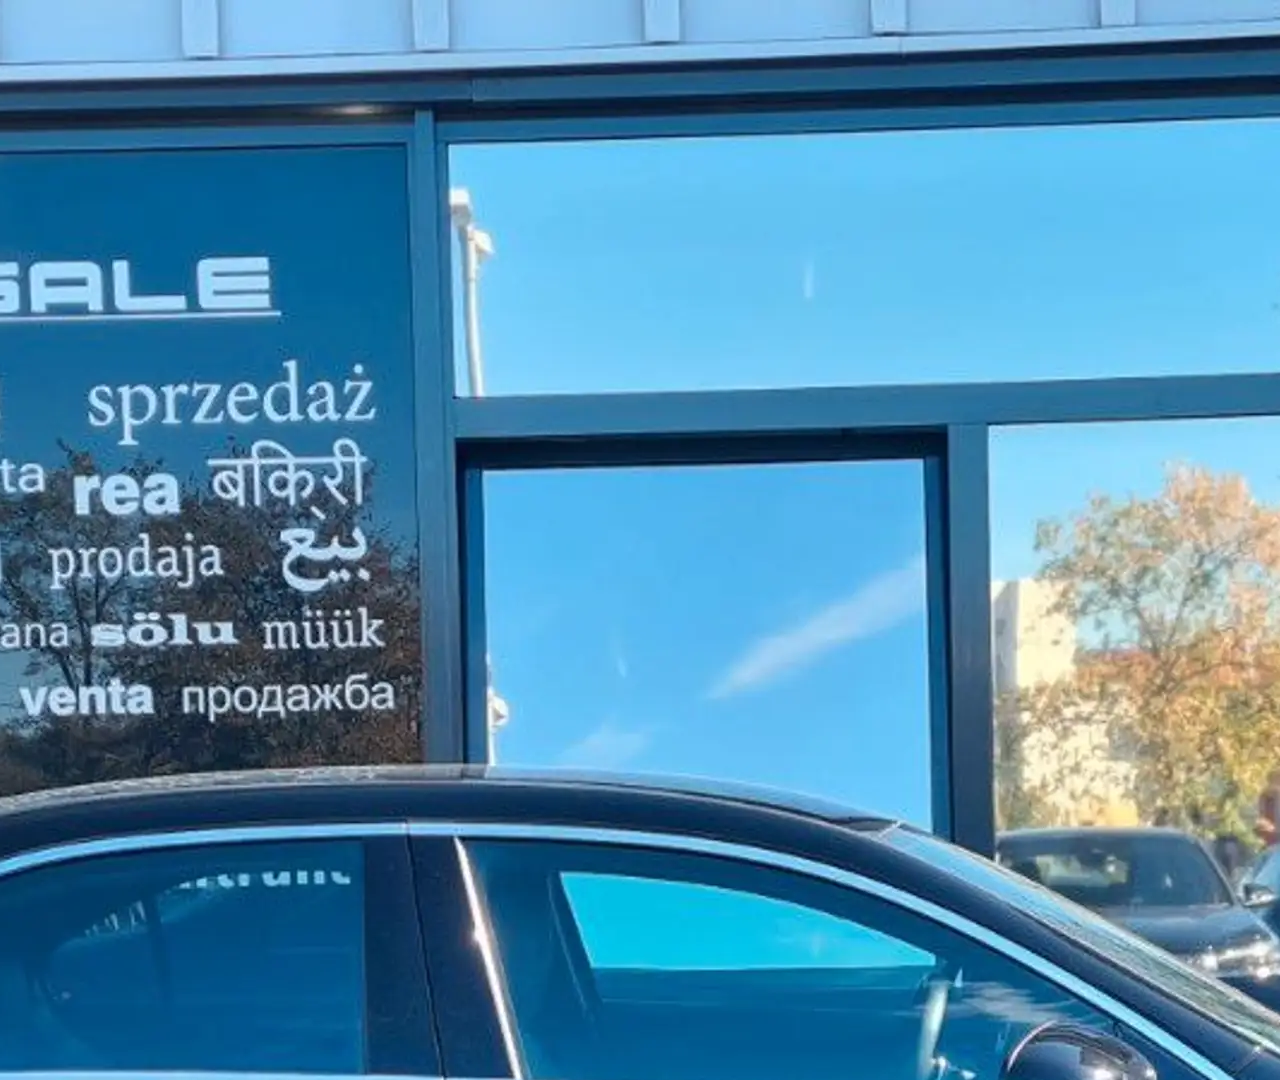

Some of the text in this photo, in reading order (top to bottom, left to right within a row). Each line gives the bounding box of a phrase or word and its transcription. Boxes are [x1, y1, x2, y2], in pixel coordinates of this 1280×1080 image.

[88, 359, 376, 446] sprzedaż
[73, 473, 181, 516] rea
[47, 532, 224, 590] prodaja
[280, 526, 371, 592] بيع
[90, 611, 239, 647] sölu
[262, 606, 386, 650] müük
[19, 677, 154, 717] venta
[182, 672, 395, 723] продажба
